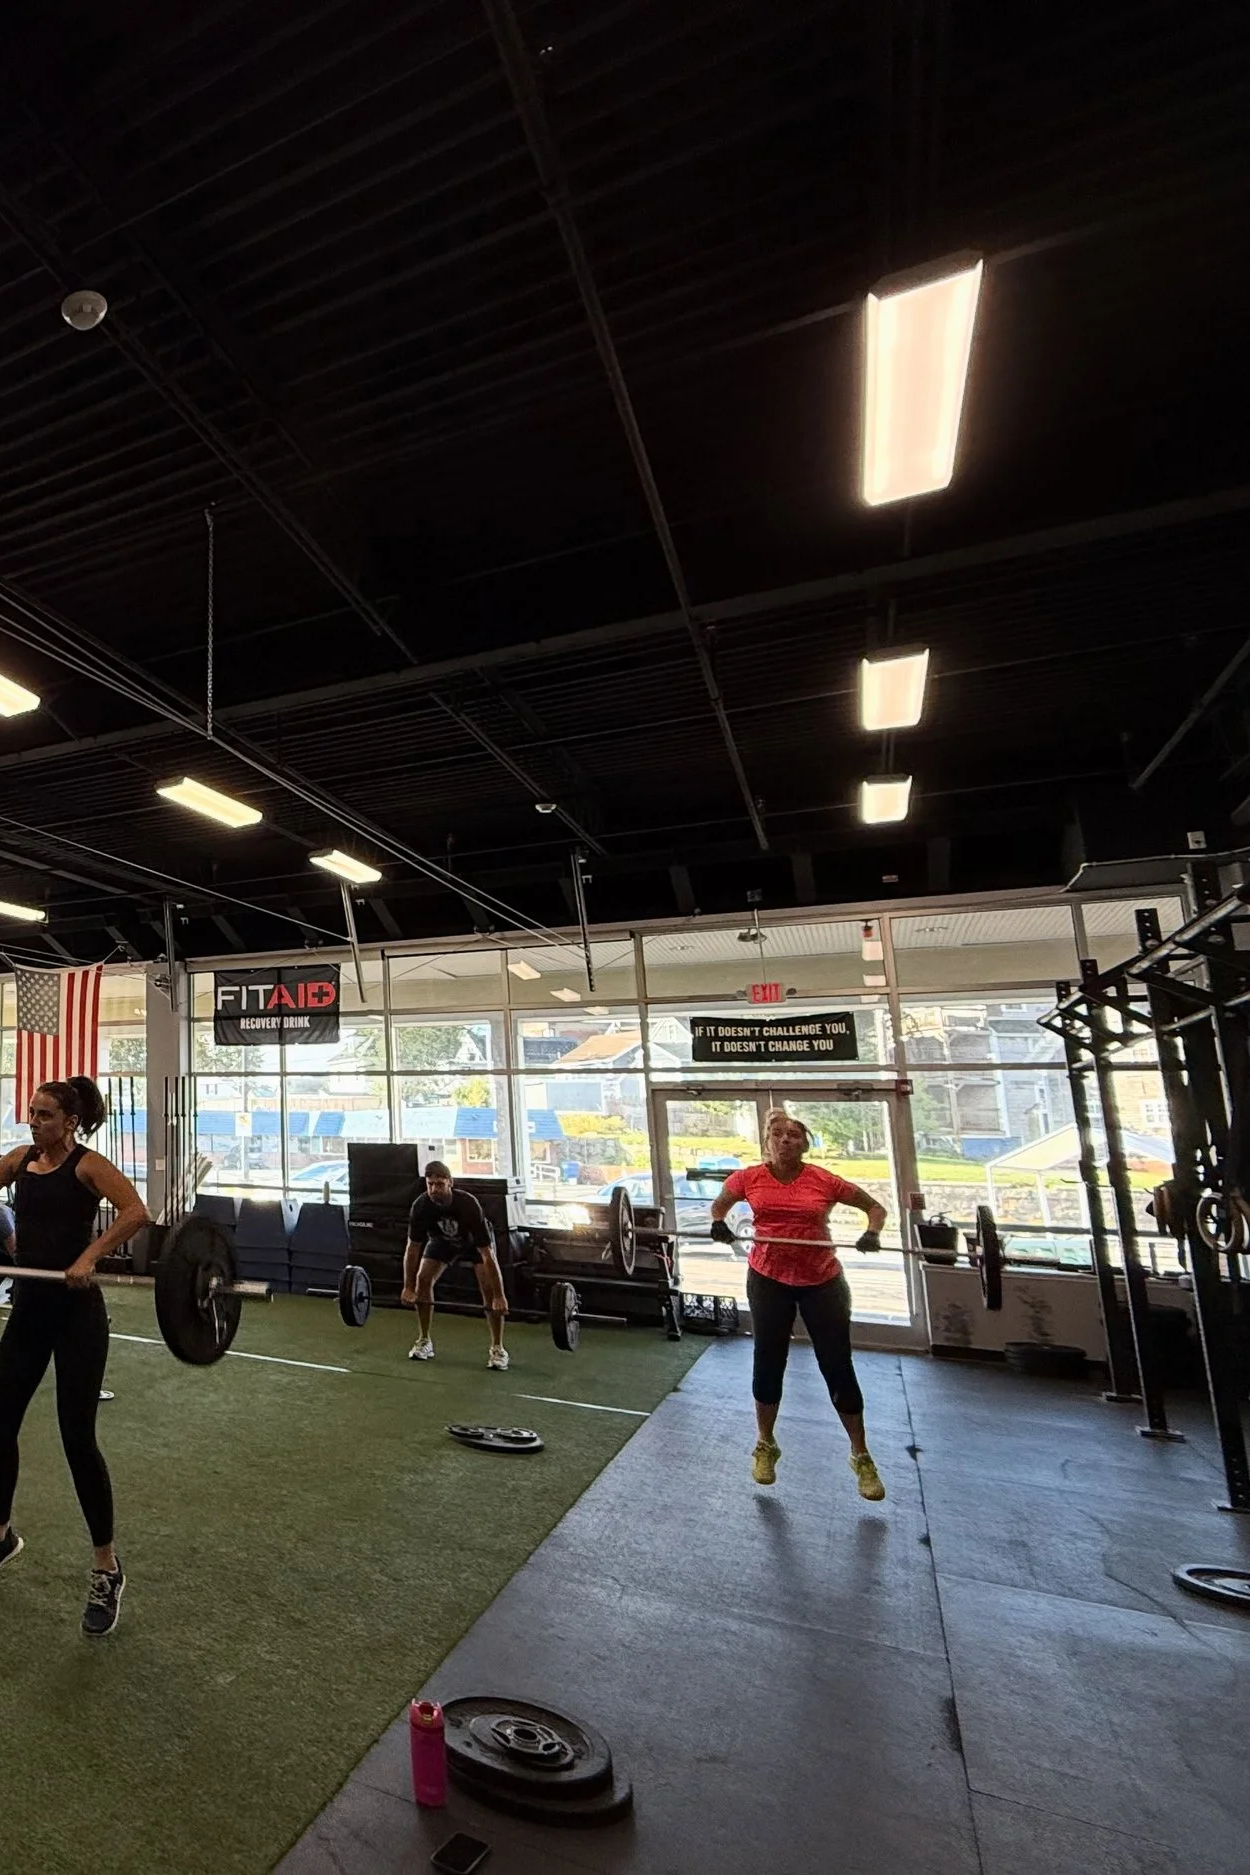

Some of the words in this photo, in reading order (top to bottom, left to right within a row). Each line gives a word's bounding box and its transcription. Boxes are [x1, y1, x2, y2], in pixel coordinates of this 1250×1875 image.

[217, 982, 336, 1010] FITAID
[752, 983, 780, 1003] EXIT
[240, 1017, 281, 1030] RECOVERY
[283, 1016, 311, 1029] DRINK
[695, 1027, 704, 1037] IF
[706, 1026, 716, 1037] IT
[718, 1026, 761, 1037] DOESN'T
[763, 1023, 822, 1036] CHALLENGE
[824, 1022, 850, 1035] YOU,
[711, 1041, 721, 1052] IT
[724, 1041, 766, 1052] DOESN'T
[768, 1040, 810, 1052] CHANGE
[812, 1039, 834, 1051] YOU
